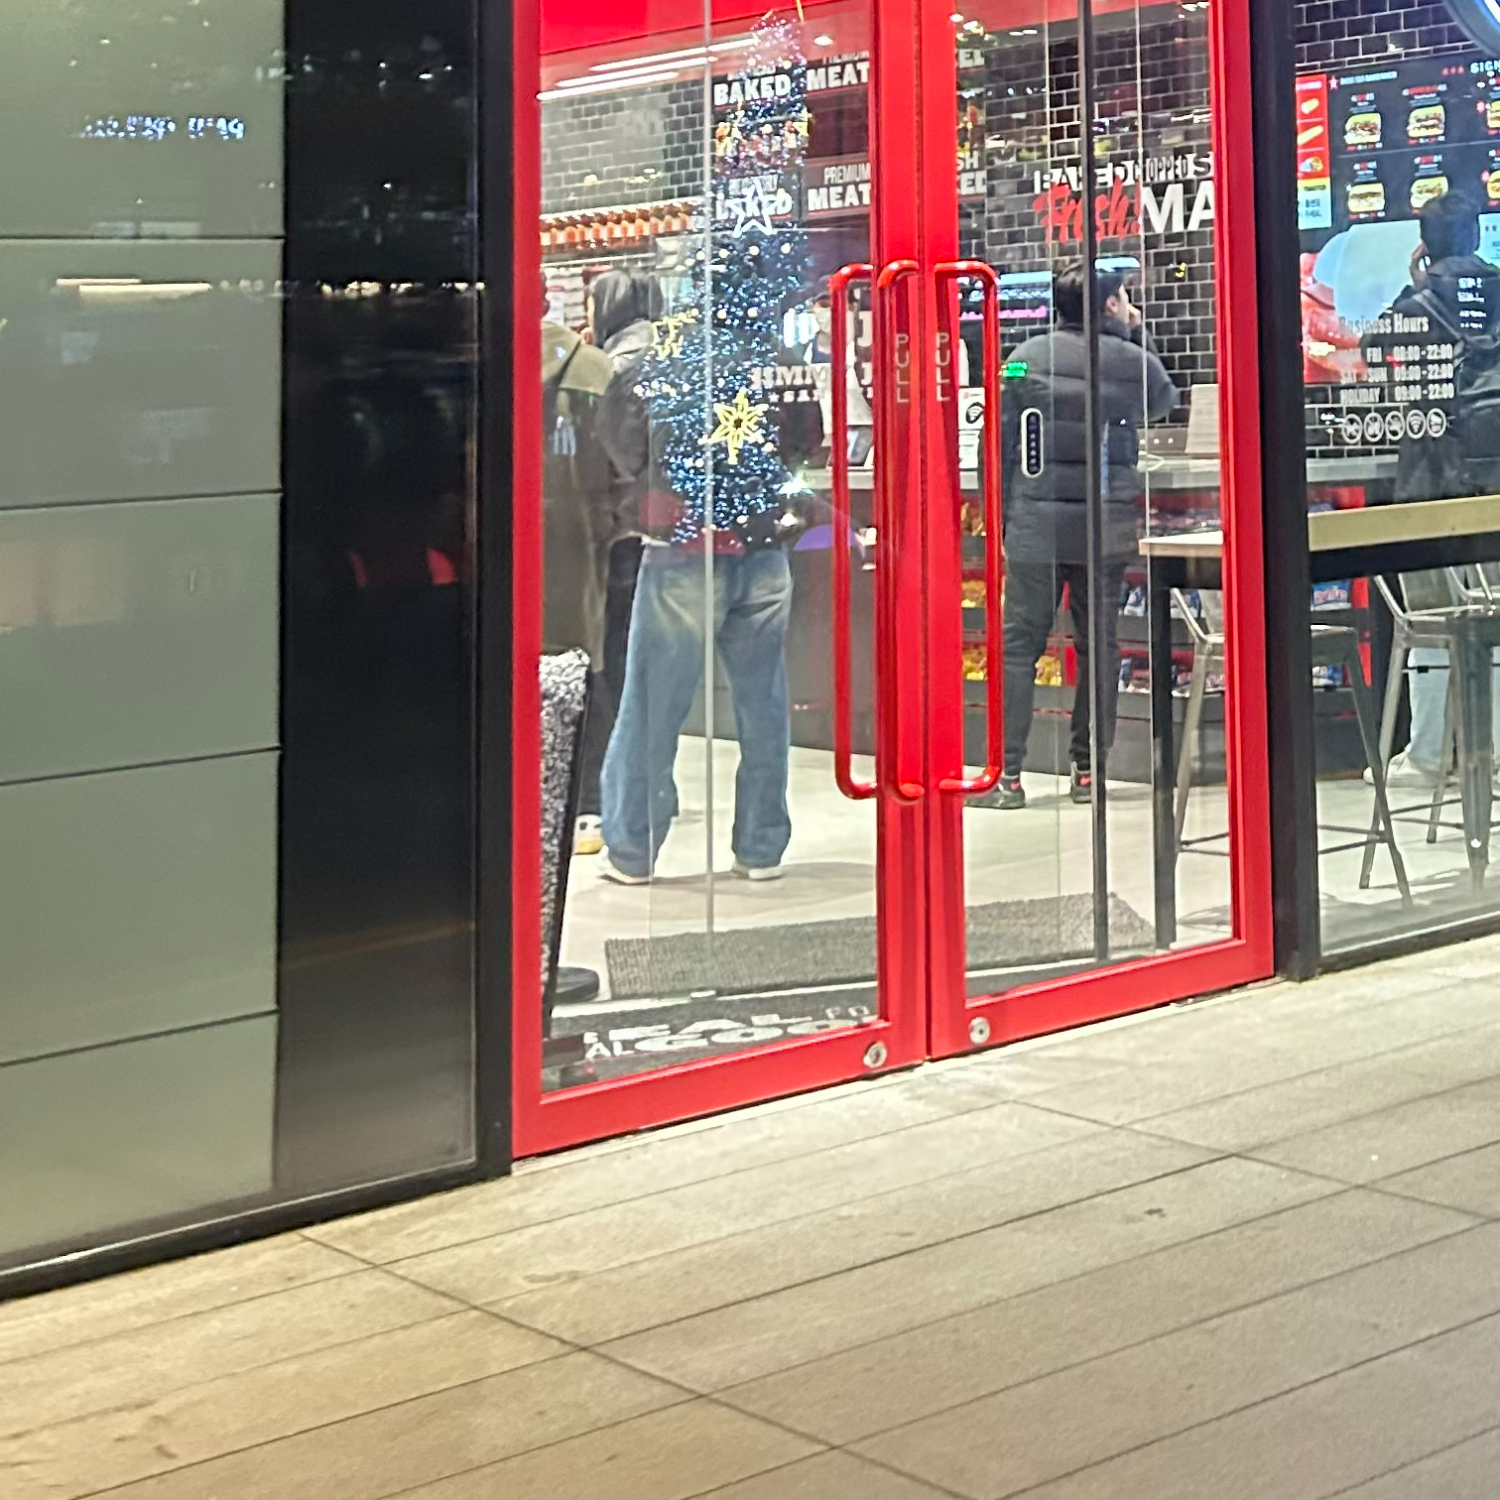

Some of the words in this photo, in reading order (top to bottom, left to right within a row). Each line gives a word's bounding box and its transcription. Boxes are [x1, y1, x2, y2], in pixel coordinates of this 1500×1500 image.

[714, 73, 792, 106] BAKED
[1032, 174, 1141, 246] Frsh!
[1339, 315, 1392, 334] Business
[1393, 312, 1430, 333] Hours
[895, 334, 910, 403] PULL
[936, 332, 950, 401] PULL
[1340, 387, 1381, 404] HOLIDAY
